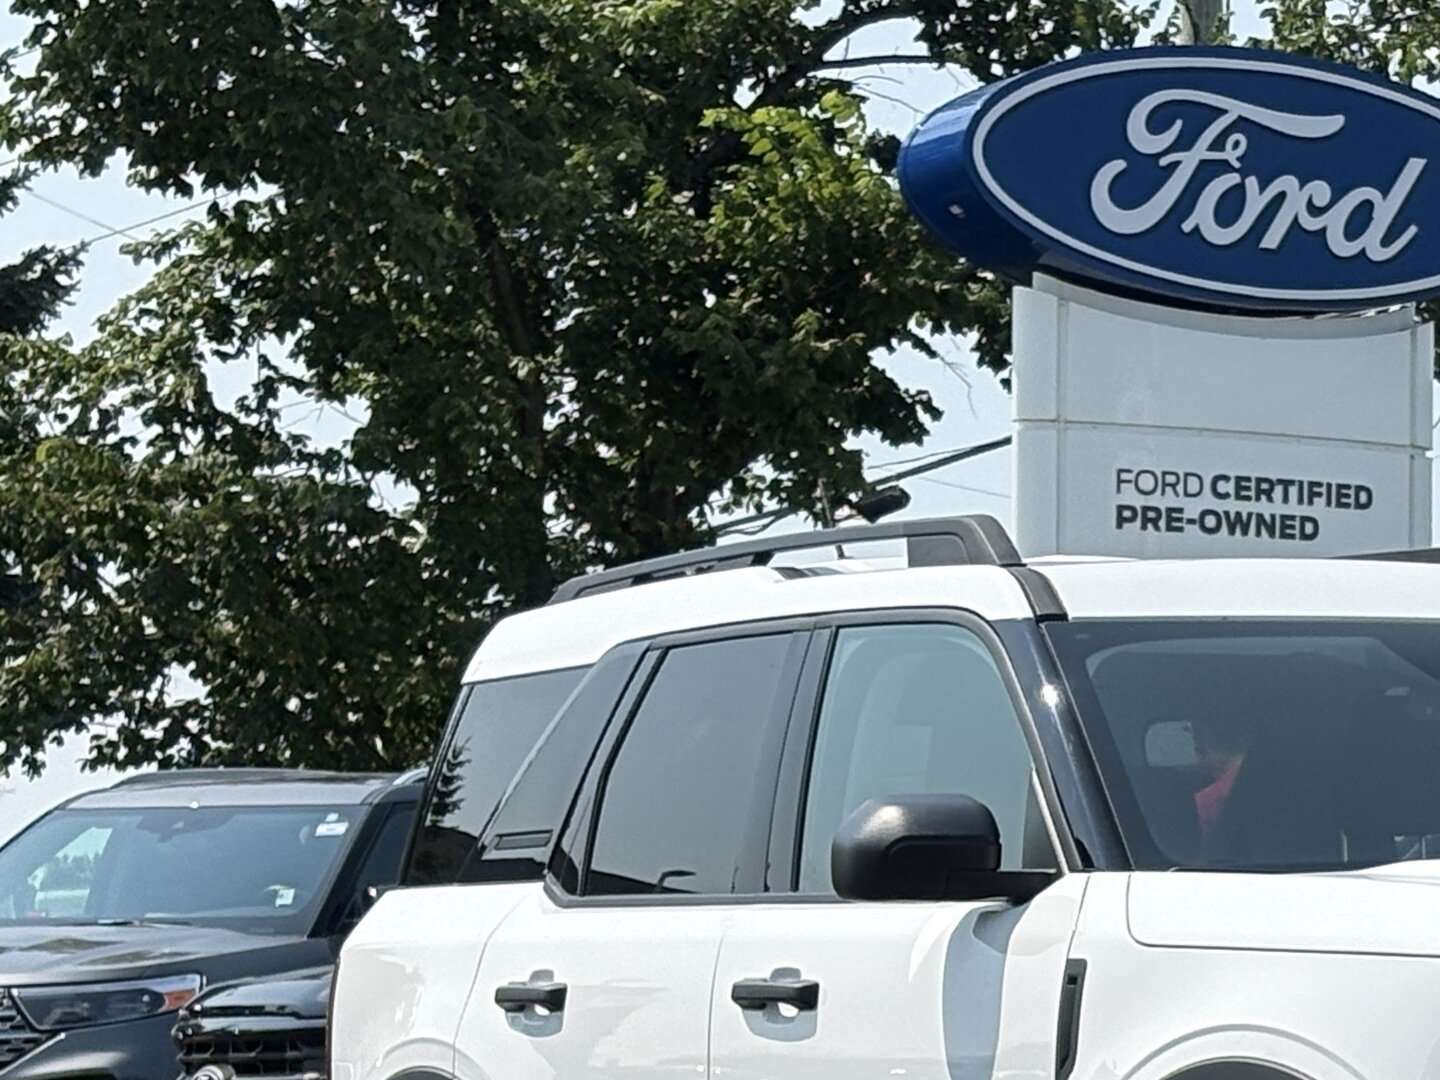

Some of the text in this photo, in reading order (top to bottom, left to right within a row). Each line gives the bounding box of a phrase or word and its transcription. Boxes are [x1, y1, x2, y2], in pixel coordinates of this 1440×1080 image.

[1091, 88, 1427, 262] Ford
[1116, 468, 1374, 511] FORD CERTIFIED
[1116, 505, 1320, 541] PRE-OWNED
